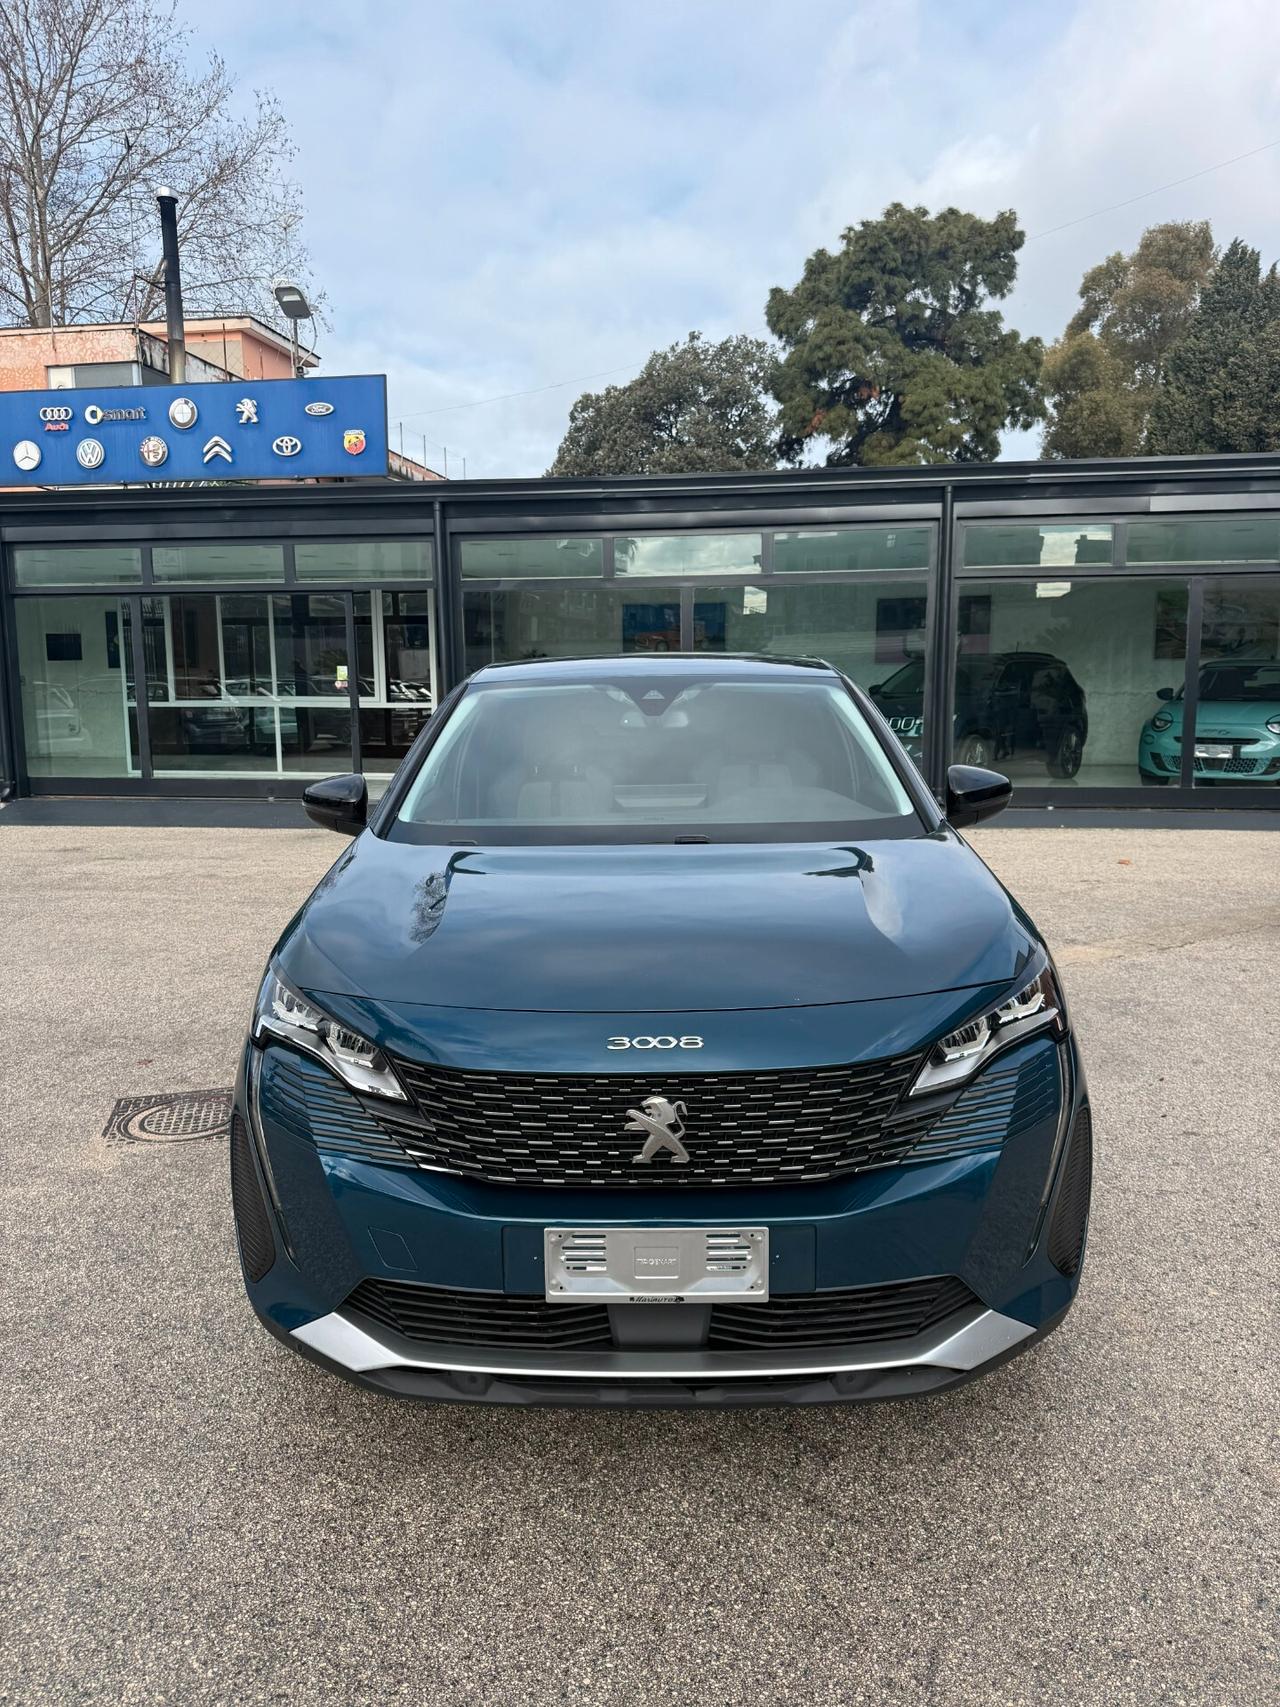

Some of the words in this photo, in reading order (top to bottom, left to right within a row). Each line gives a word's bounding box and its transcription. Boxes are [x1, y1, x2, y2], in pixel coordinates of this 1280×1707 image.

[103, 407, 147, 420] smart
[45, 423, 69, 431] Audi
[607, 1036, 704, 1049] 3008
